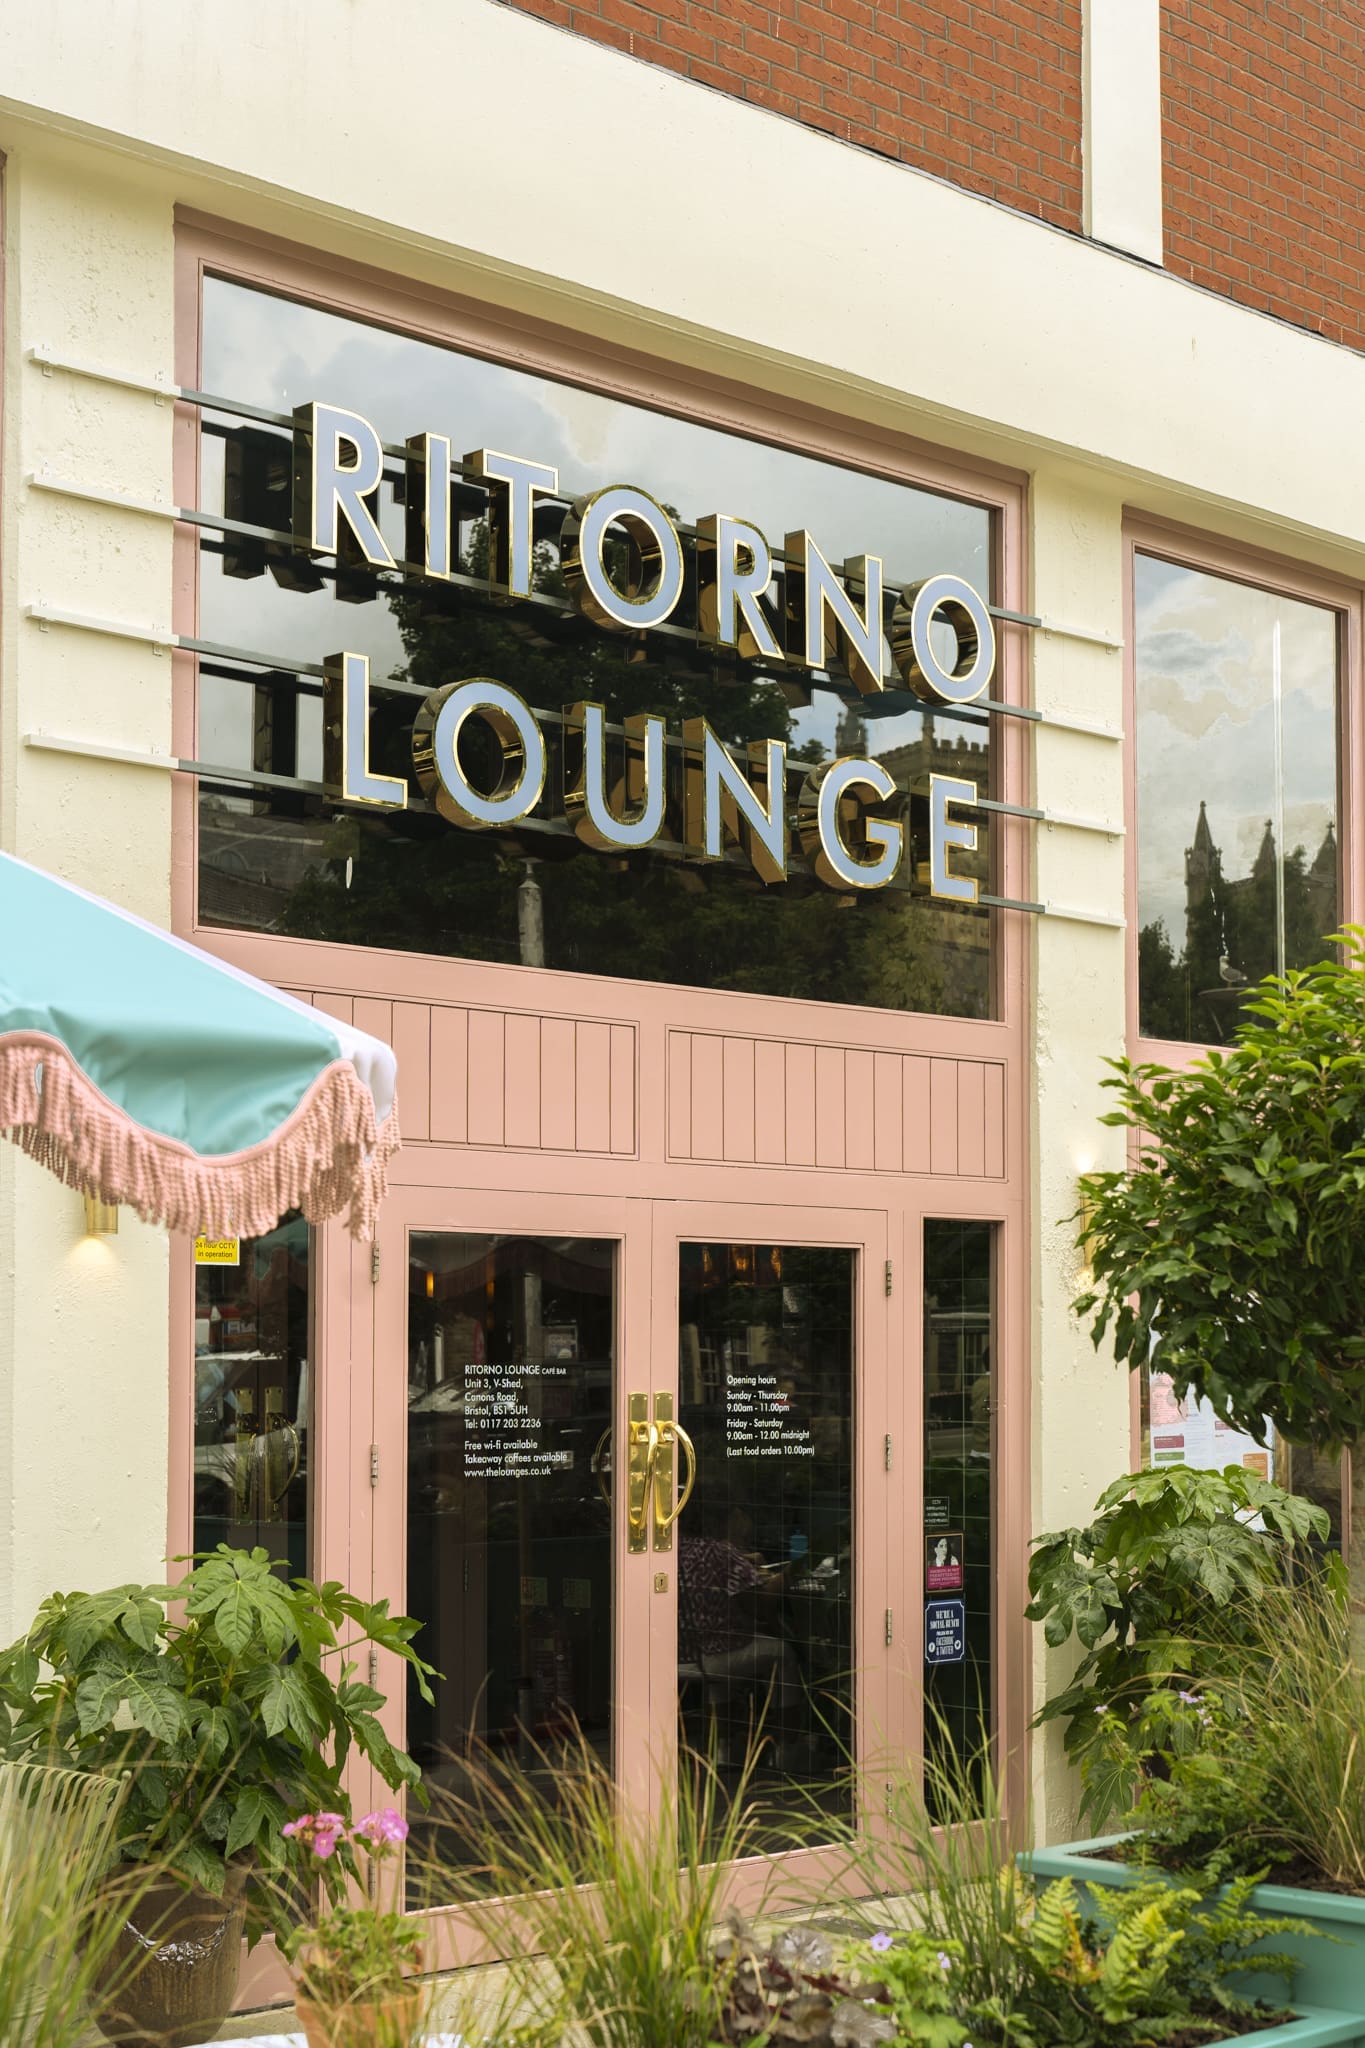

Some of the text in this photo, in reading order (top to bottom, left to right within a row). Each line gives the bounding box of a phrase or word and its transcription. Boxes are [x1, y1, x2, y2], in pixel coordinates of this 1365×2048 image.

[309, 401, 997, 704] RITORNO
[340, 652, 980, 904] LOUNGE
[464, 1364, 503, 1375] RITORNO
[504, 1364, 540, 1375] LOUNGE
[464, 1378, 524, 1390] Unit 3, V-Shed,
[726, 1375, 777, 1386] Opening hours
[464, 1391, 519, 1403] Canons Road,
[726, 1391, 752, 1402] Sunday
[758, 1390, 788, 1401] Thursday
[464, 1405, 529, 1416] Bristol, BS1 5UH
[726, 1403, 753, 1412] 9.00am
[760, 1403, 790, 1414] 11.00pm
[464, 1418, 541, 1429] Tel: 0117 203 2236
[726, 1418, 748, 1429] Friday
[753, 1418, 783, 1429] Saturday
[726, 1431, 753, 1440] 9.00am
[760, 1431, 780, 1440] 12.00
[780, 1430, 809, 1441] midnight
[464, 1439, 538, 1451] Free wi-fi available
[726, 1445, 815, 1458] (Last food orders 10.00pm)
[464, 1452, 568, 1465] Takeaway coffees available
[464, 1466, 552, 1478] www.thelounges.co.uk
